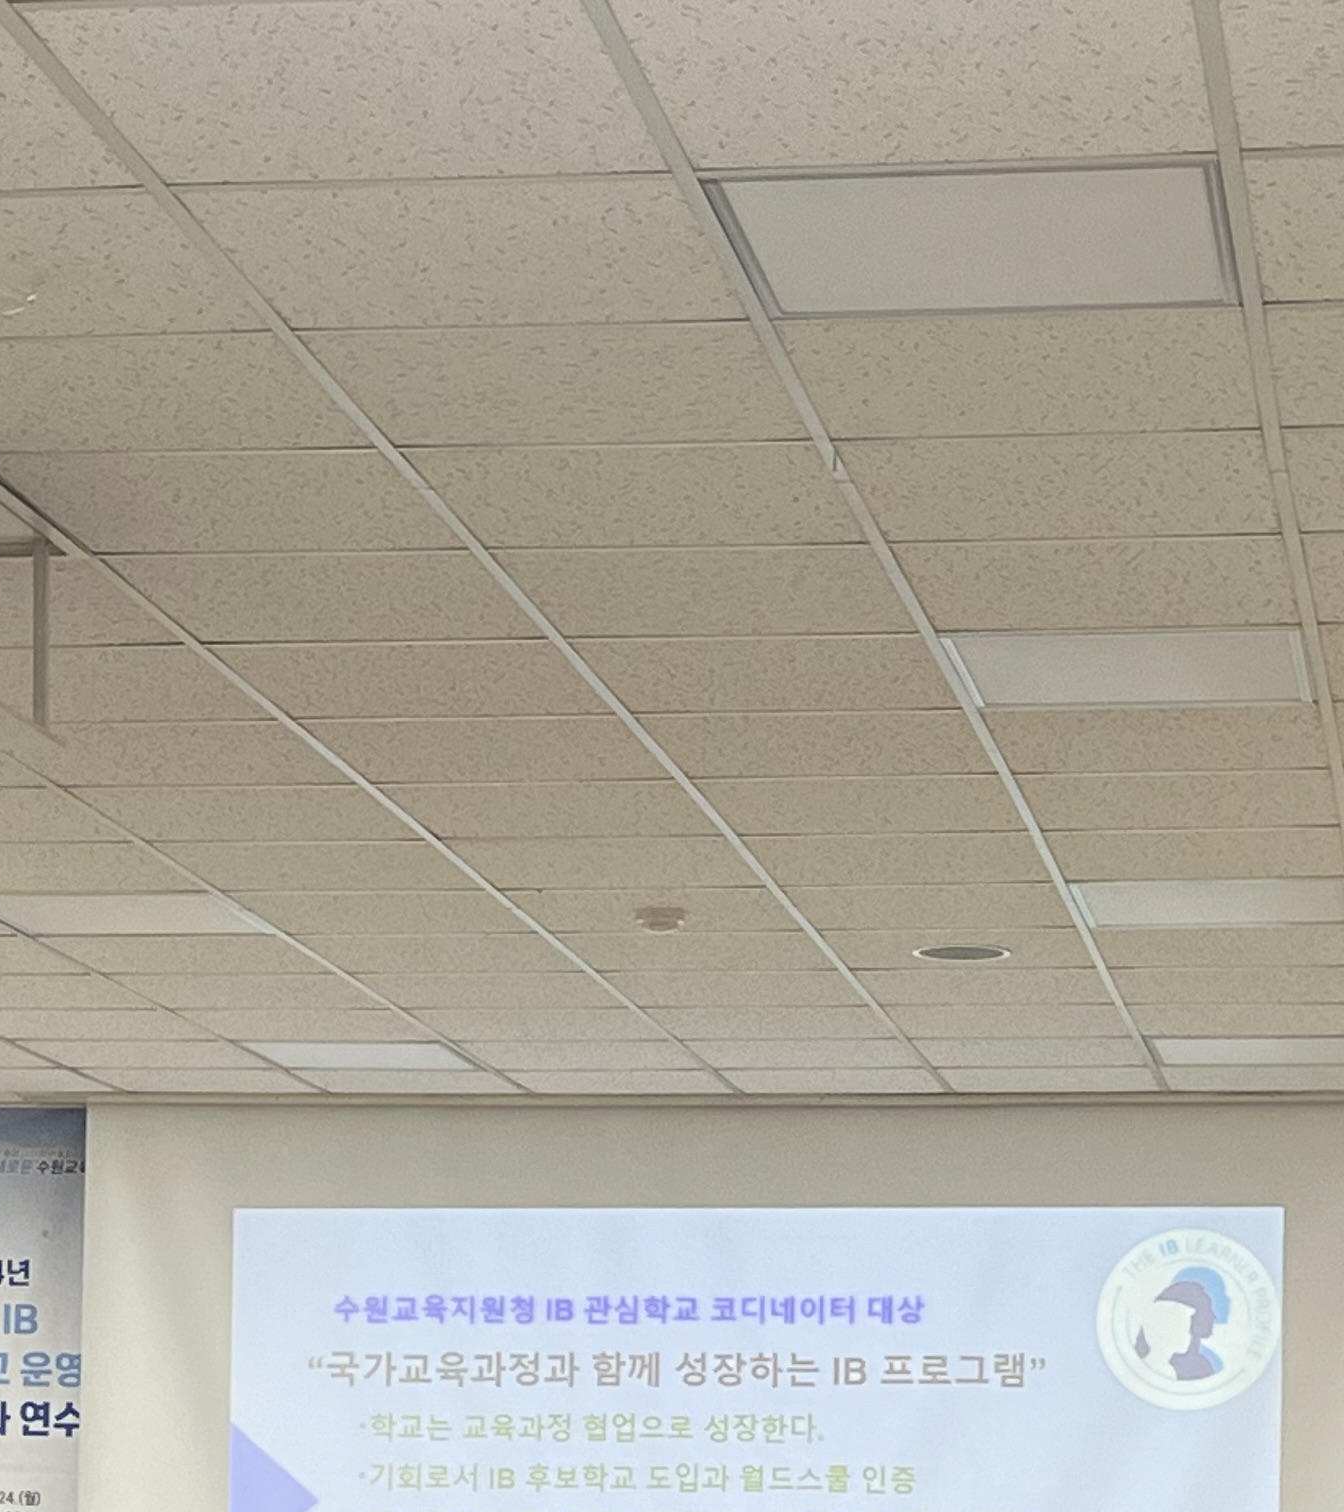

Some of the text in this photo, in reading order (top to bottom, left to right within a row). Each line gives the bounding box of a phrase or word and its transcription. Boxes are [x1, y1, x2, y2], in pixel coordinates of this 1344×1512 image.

[1159, 1238, 1180, 1257] IB
[4, 1304, 38, 1335] IB
[334, 1294, 925, 1325] 수원교육지원청 IB 관심학교 코디네이터 대상
[20, 1351, 81, 1388] 운영
[308, 1351, 1046, 1388] “국가교육과정과 함께 성장하는 IB 프로그램”
[20, 1401, 80, 1437] 연수
[372, 1413, 824, 1443] 학교는 교육과정 협업으로 성장한다.
[371, 1464, 916, 1494] 기회로서 IB 후보학교 도입과 월드스쿨 인증
